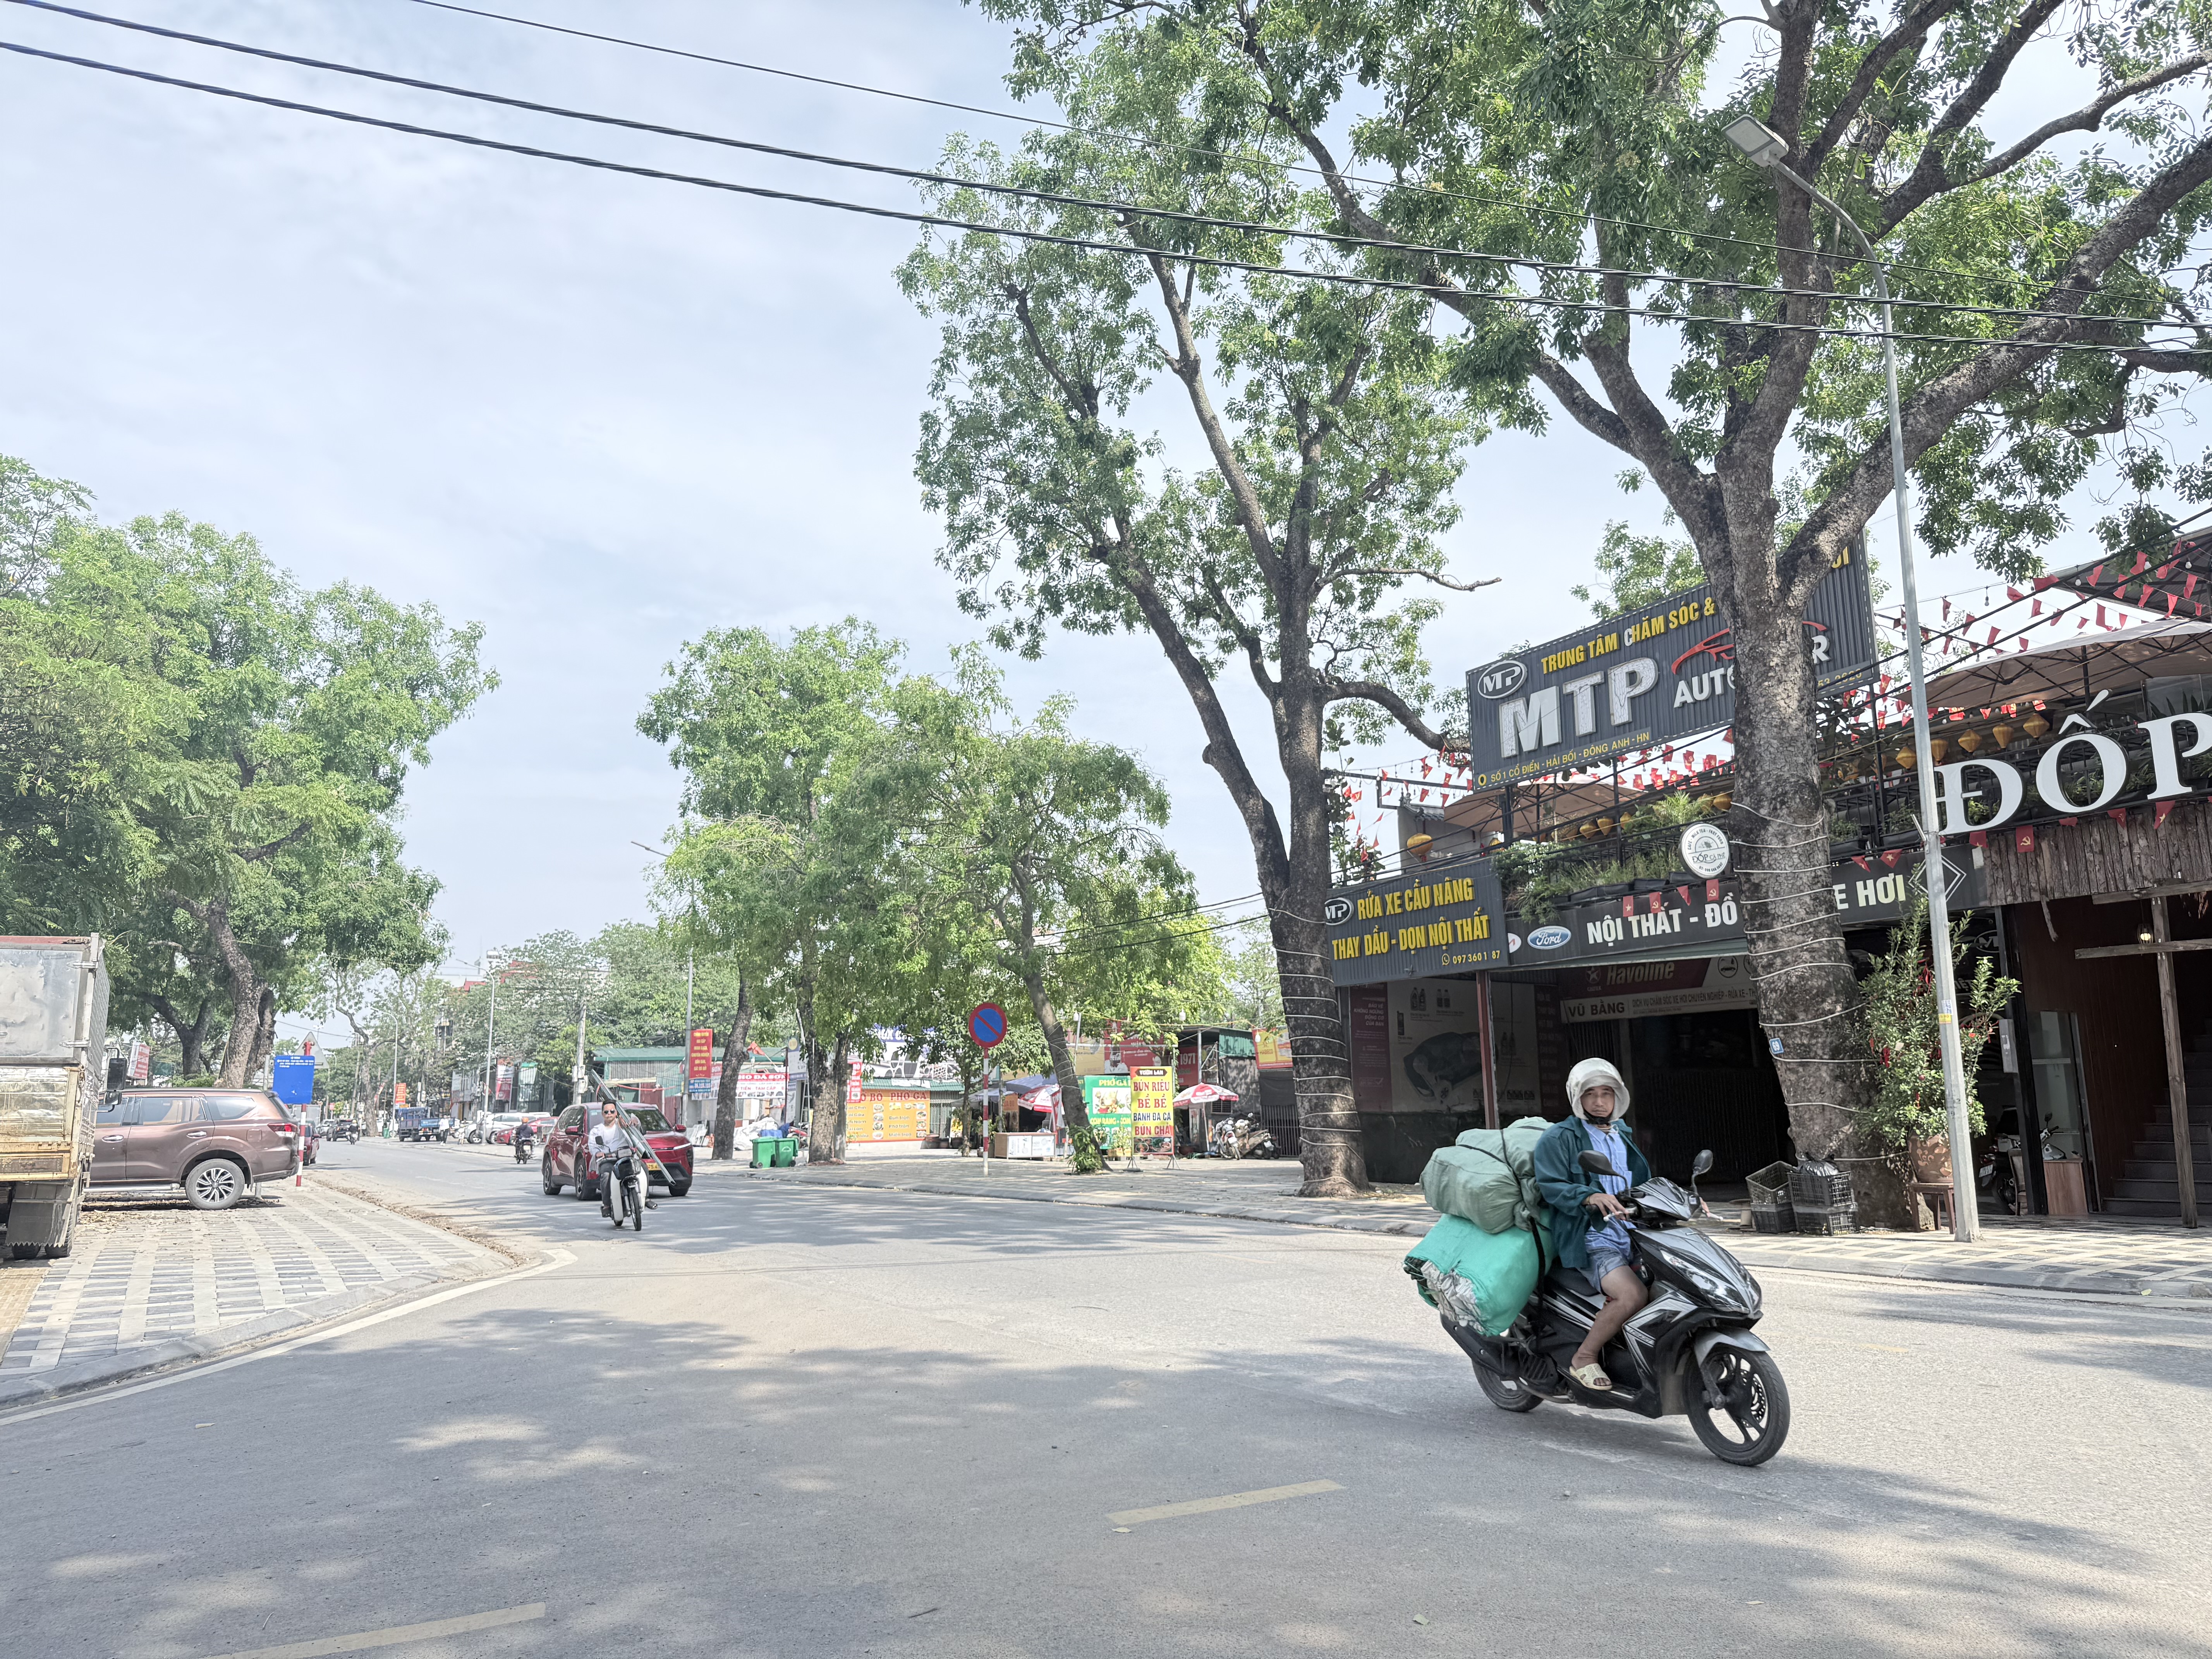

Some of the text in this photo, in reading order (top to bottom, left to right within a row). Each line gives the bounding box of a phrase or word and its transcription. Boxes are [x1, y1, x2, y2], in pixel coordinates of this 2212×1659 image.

[1541, 597, 1716, 674] TRUNG TÂM CHĂM SÓC &
[1483, 666, 1521, 694] MTP
[1499, 658, 1659, 759] MTP
[1491, 770, 1501, 782] SỐ
[1509, 763, 1520, 777] CỔ
[1522, 759, 1540, 774] ĐIỂN
[1546, 755, 1560, 768] HẢI
[1562, 749, 1576, 764] BỐI
[1583, 743, 1608, 758] ĐÔNG
[1611, 737, 1630, 750] ANH
[1637, 732, 1649, 743] HN
[1934, 689, 2212, 836] ĐỐP
[1357, 877, 1475, 920] RỬA XE CẦU NÂNG
[1587, 915, 1623, 946] NỘI
[1628, 902, 1681, 938] THẤT
[1705, 892, 1738, 927] ĐỒ
[1856, 873, 1906, 907] HƠI
[1332, 936, 1360, 960] THAY
[1364, 925, 1389, 956] DẦU
[1399, 926, 1427, 955] DỌN
[1428, 916, 1454, 950] NỘI
[1455, 907, 1490, 943] THẤT
[1536, 930, 1561, 946] Ford
[1607, 962, 1675, 986] Havoline
[1568, 1003, 1585, 1017] VŨ
[1590, 999, 1625, 1016] BẰNG
[1772, 1041, 1780, 1051] 69
[1181, 1053, 1195, 1065] 1971
[870, 1091, 883, 1101] BÒ
[891, 1090, 910, 1100] PHỞ
[1133, 1079, 1149, 1091] BÚN
[1152, 1079, 1170, 1091] RIÊU
[1137, 1093, 1167, 1108] BỀ BỀ
[1135, 1122, 1170, 1135] BÚN CHẢ
